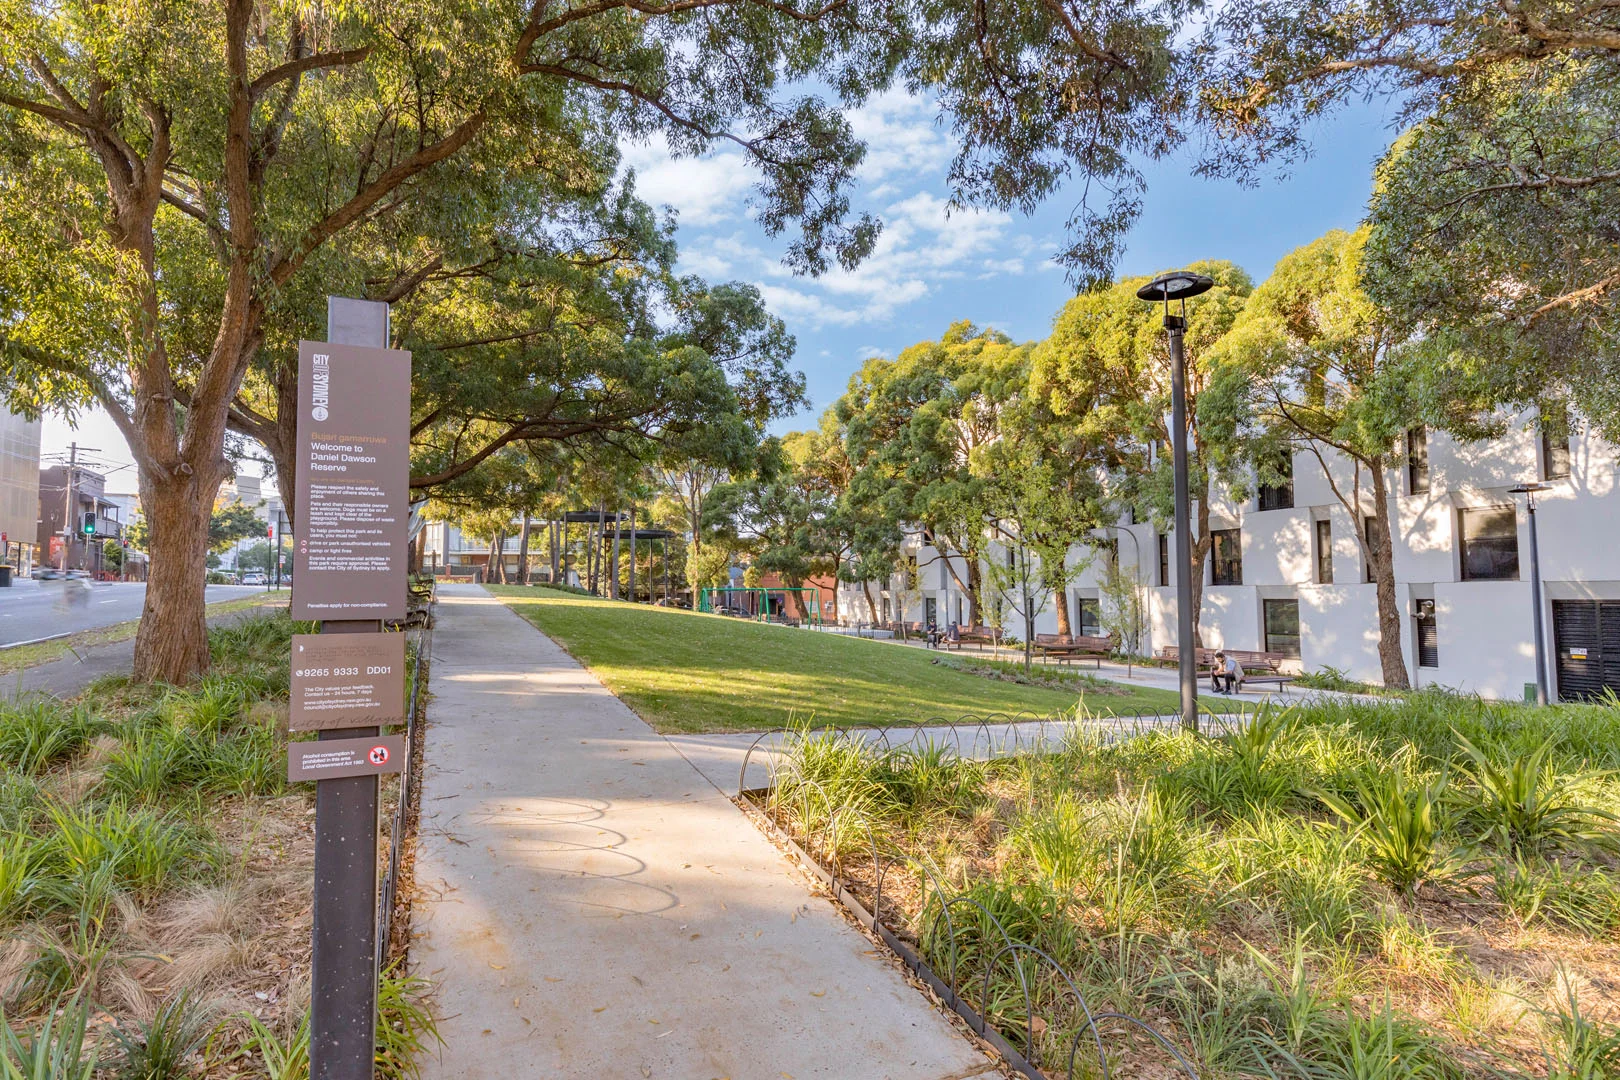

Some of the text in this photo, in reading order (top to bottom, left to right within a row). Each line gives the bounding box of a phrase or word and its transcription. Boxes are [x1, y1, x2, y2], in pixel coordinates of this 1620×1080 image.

[313, 354, 329, 364] CITY
[312, 374, 328, 408] SYDNEY
[311, 442, 352, 452] Welcome
[311, 463, 346, 471] Reserve
